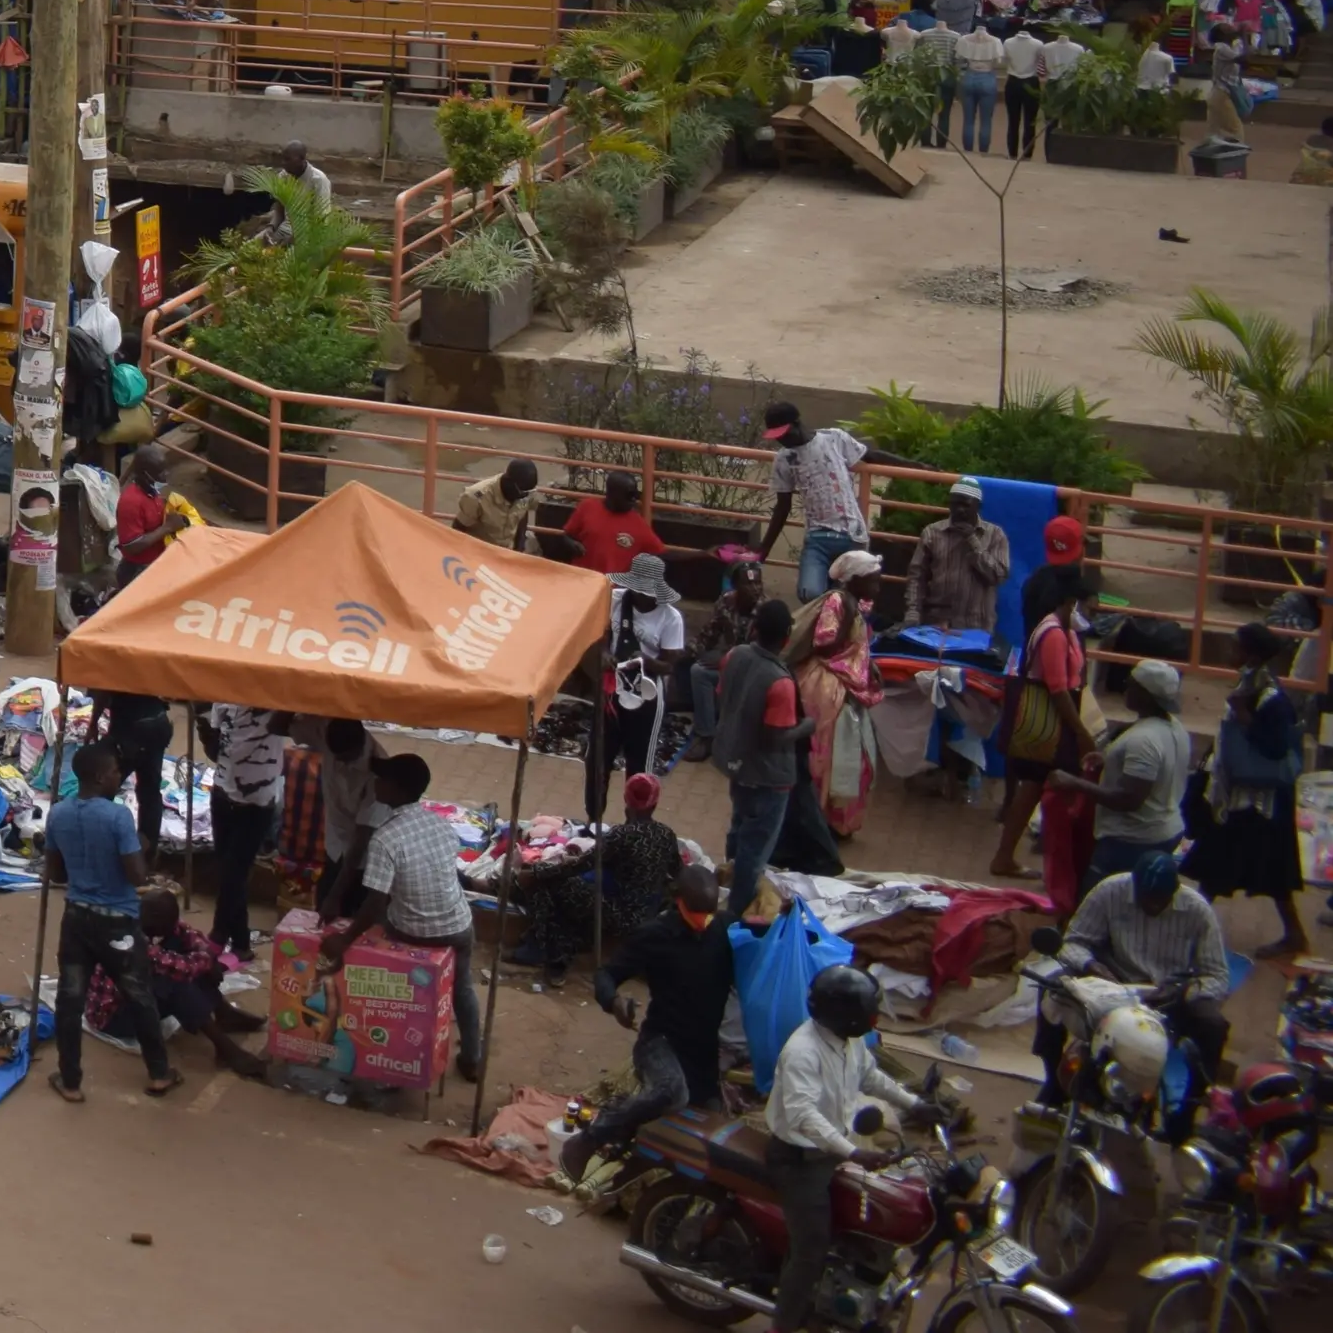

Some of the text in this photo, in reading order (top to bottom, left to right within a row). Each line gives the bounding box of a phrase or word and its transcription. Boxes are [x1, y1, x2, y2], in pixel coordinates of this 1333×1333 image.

[434, 564, 532, 670] africell
[174, 597, 410, 676] africell
[347, 967, 386, 982] MEET
[280, 976, 299, 995] 4G
[349, 981, 413, 999] BUNDLES
[366, 999, 388, 1009] BEST
[389, 1002, 426, 1013] OFFERS
[378, 1009, 406, 1019] TOWN
[366, 1053, 421, 1075] africell
